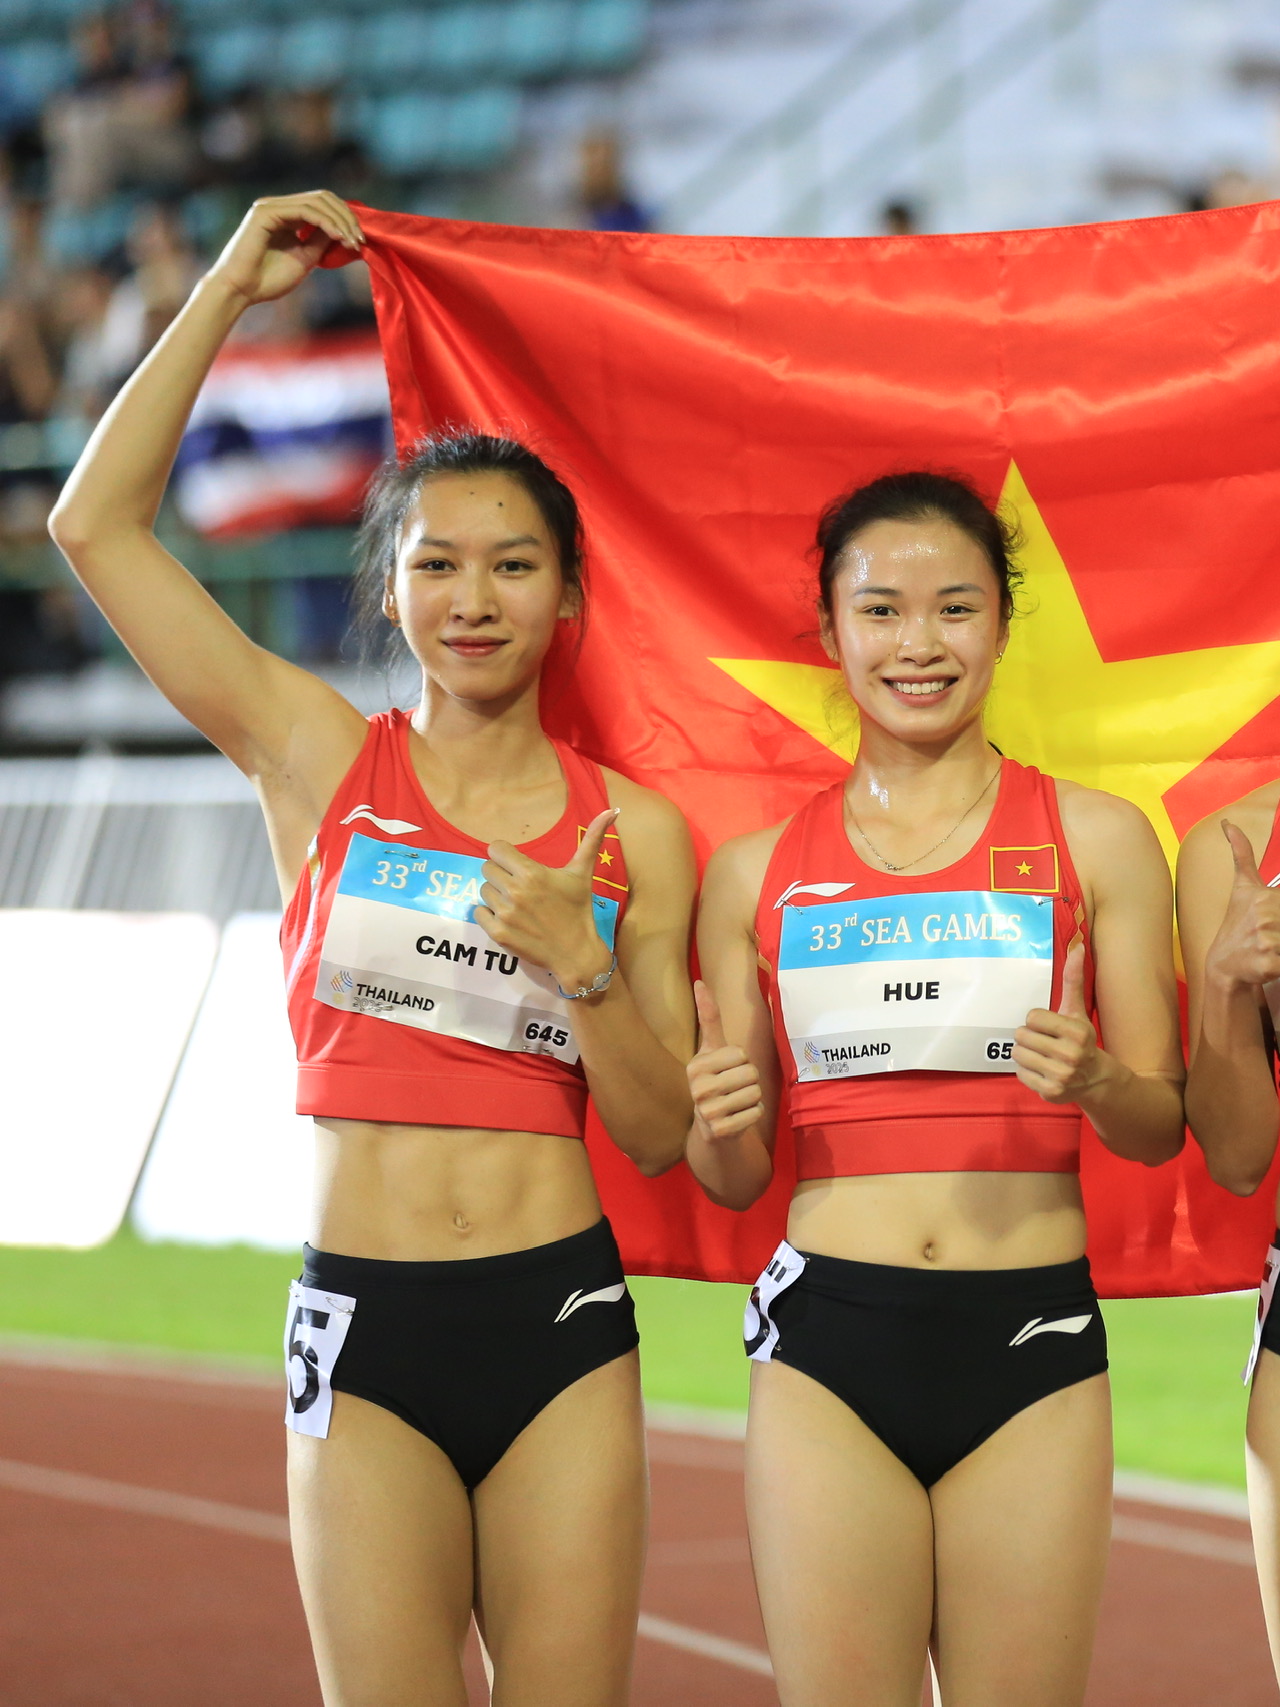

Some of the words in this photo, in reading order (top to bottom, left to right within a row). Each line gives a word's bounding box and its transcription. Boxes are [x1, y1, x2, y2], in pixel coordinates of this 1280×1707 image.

[372, 860, 428, 889] 33rd
[426, 870, 479, 905] SEA
[810, 913, 858, 951] 33rd
[861, 916, 912, 947] SEA
[922, 914, 1022, 942] GAMES
[416, 935, 478, 966] CAM
[484, 949, 519, 976] TU
[356, 983, 435, 1011] THAILAND
[884, 981, 940, 1002] HUE
[525, 1022, 568, 1047] 645
[821, 1043, 891, 1062] THAILAND
[987, 1042, 1014, 1060] 65
[288, 1306, 331, 1414] 5
